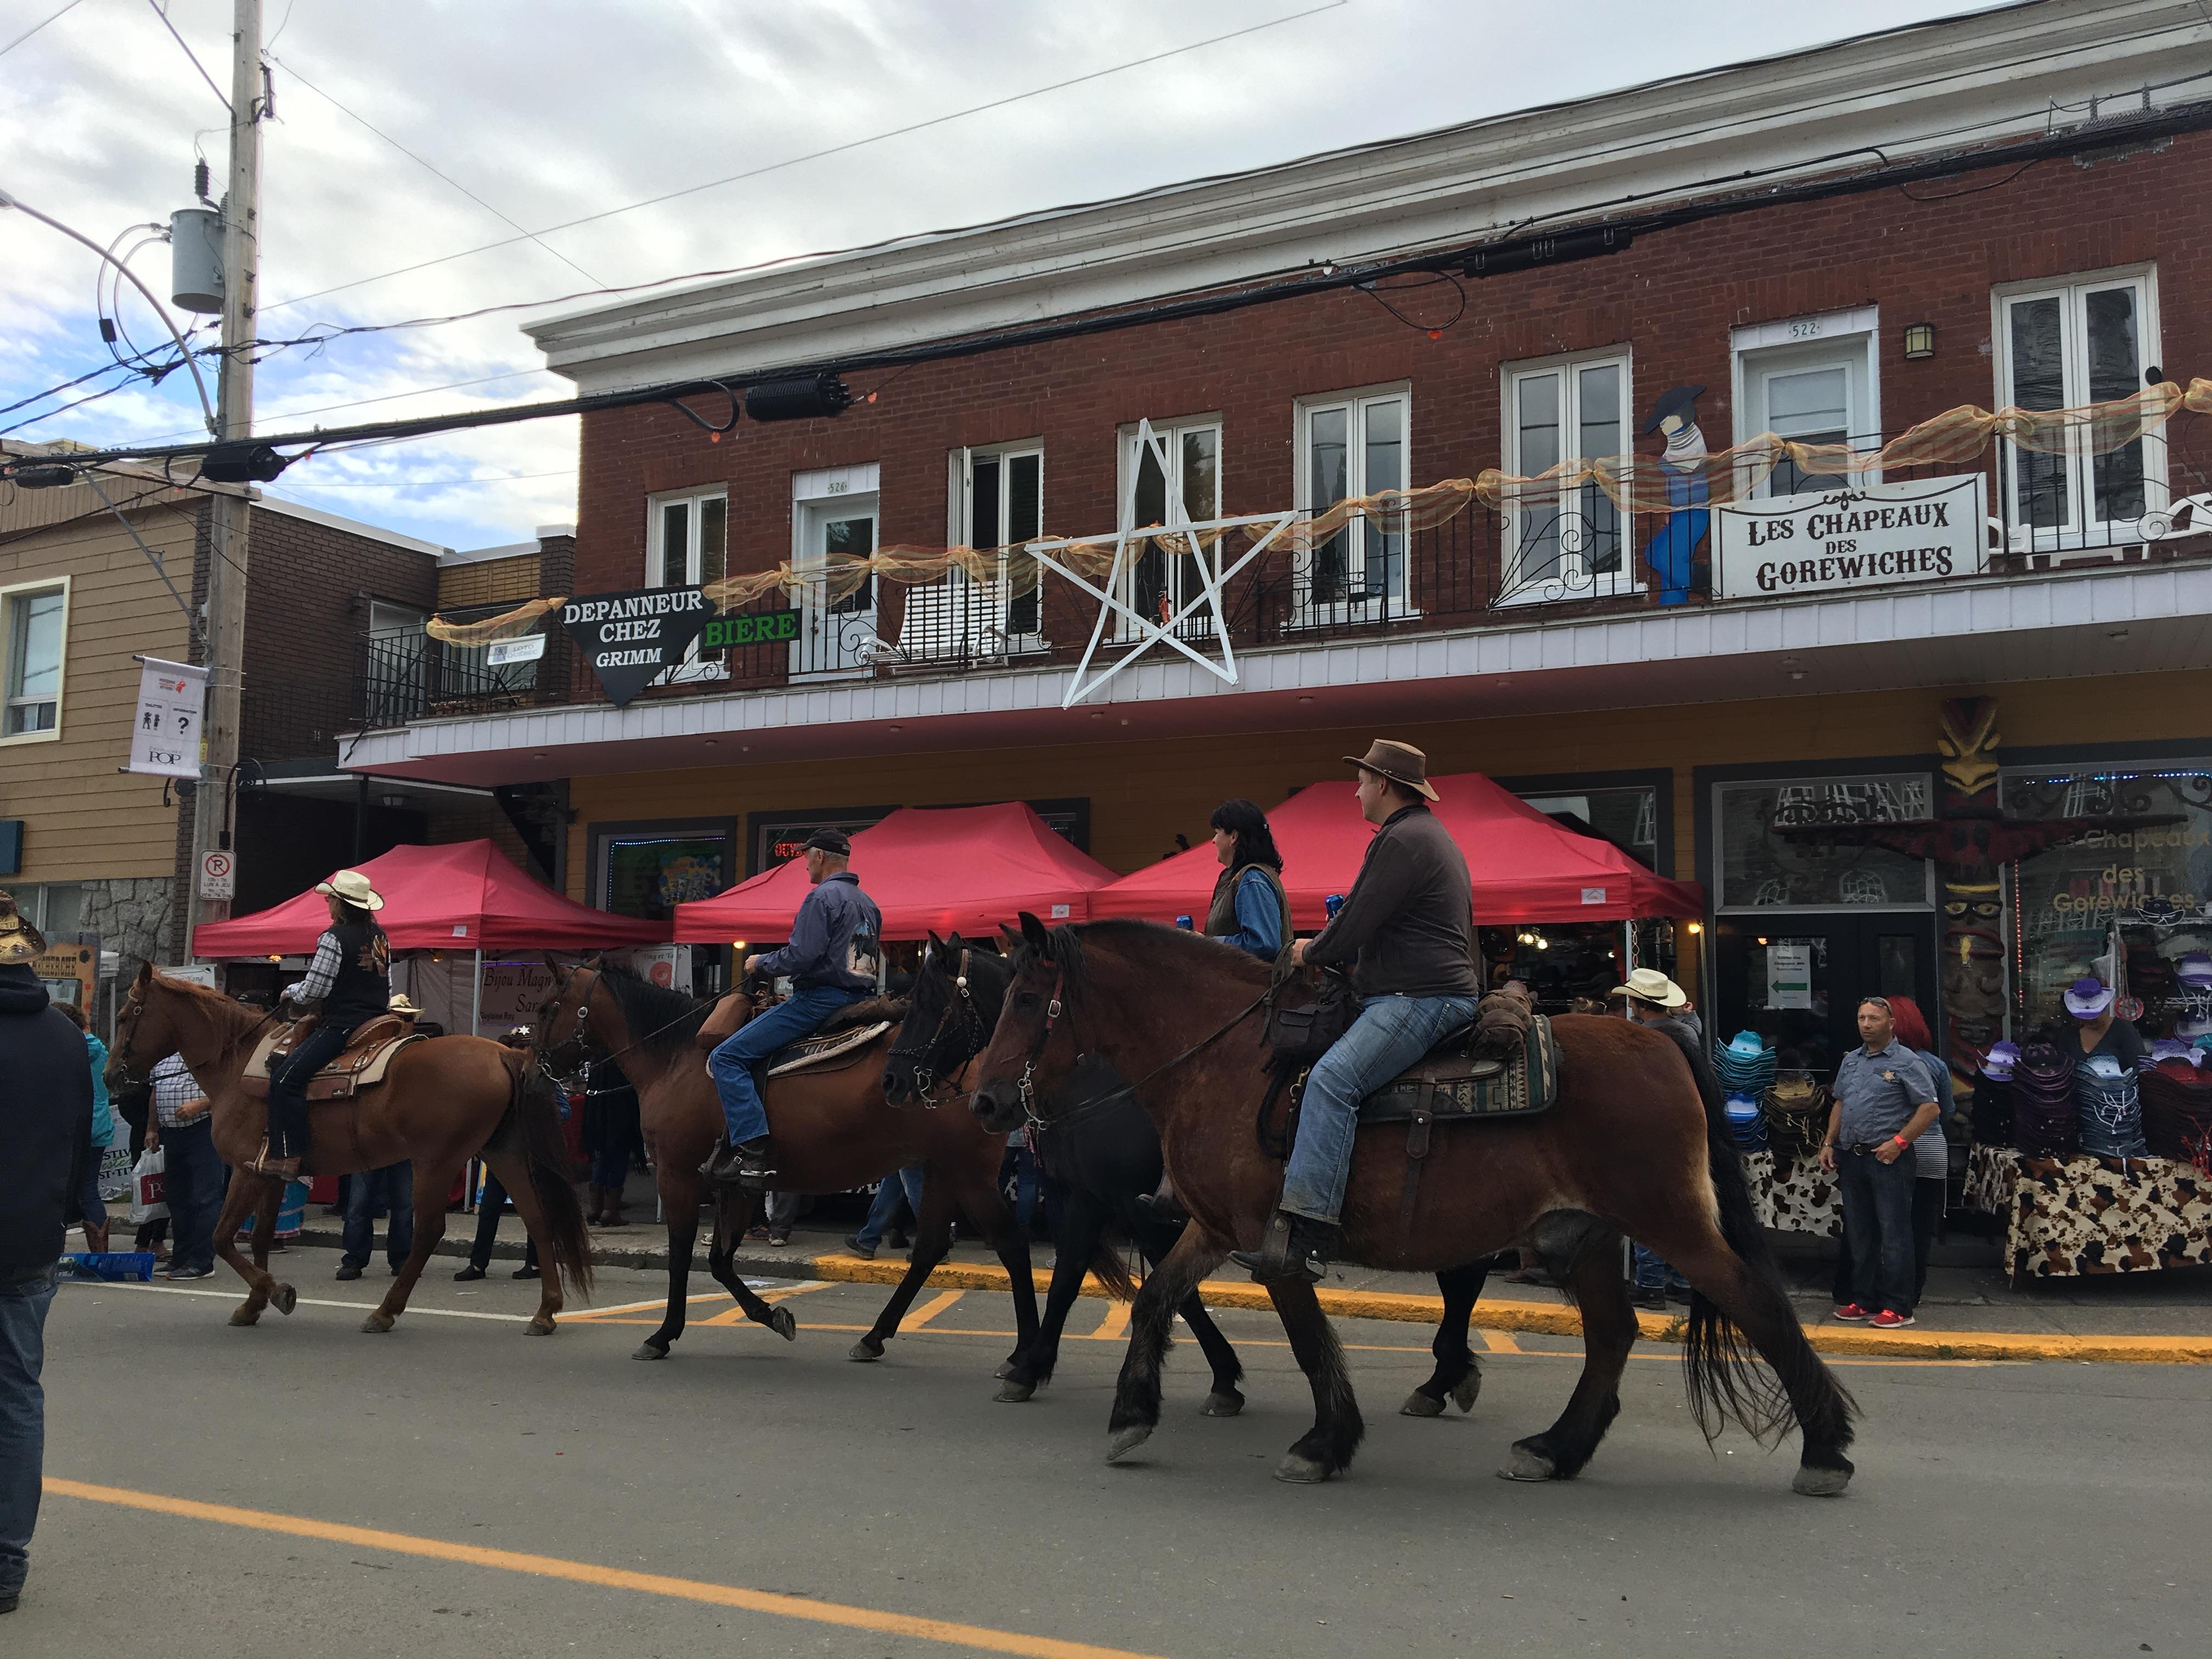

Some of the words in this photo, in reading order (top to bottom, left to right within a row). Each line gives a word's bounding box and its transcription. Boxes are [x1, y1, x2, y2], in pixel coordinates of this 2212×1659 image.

[1793, 323, 1816, 337] 522
[830, 482, 845, 493] 526
[1747, 519, 1794, 546] LES
[1806, 502, 1949, 540] CHAPEAUX
[1825, 539, 1857, 554] DES
[1757, 546, 1953, 591] GOREWICHES
[564, 590, 703, 624] DEPANNEUR
[599, 619, 661, 643] CHEZ
[704, 613, 797, 647] BIÈRE
[596, 647, 663, 668] GRIMM
[149, 751, 181, 765] POP
[2102, 864, 2144, 884] des
[483, 967, 513, 992] Bijou
[504, 1012, 515, 1022] Roy
